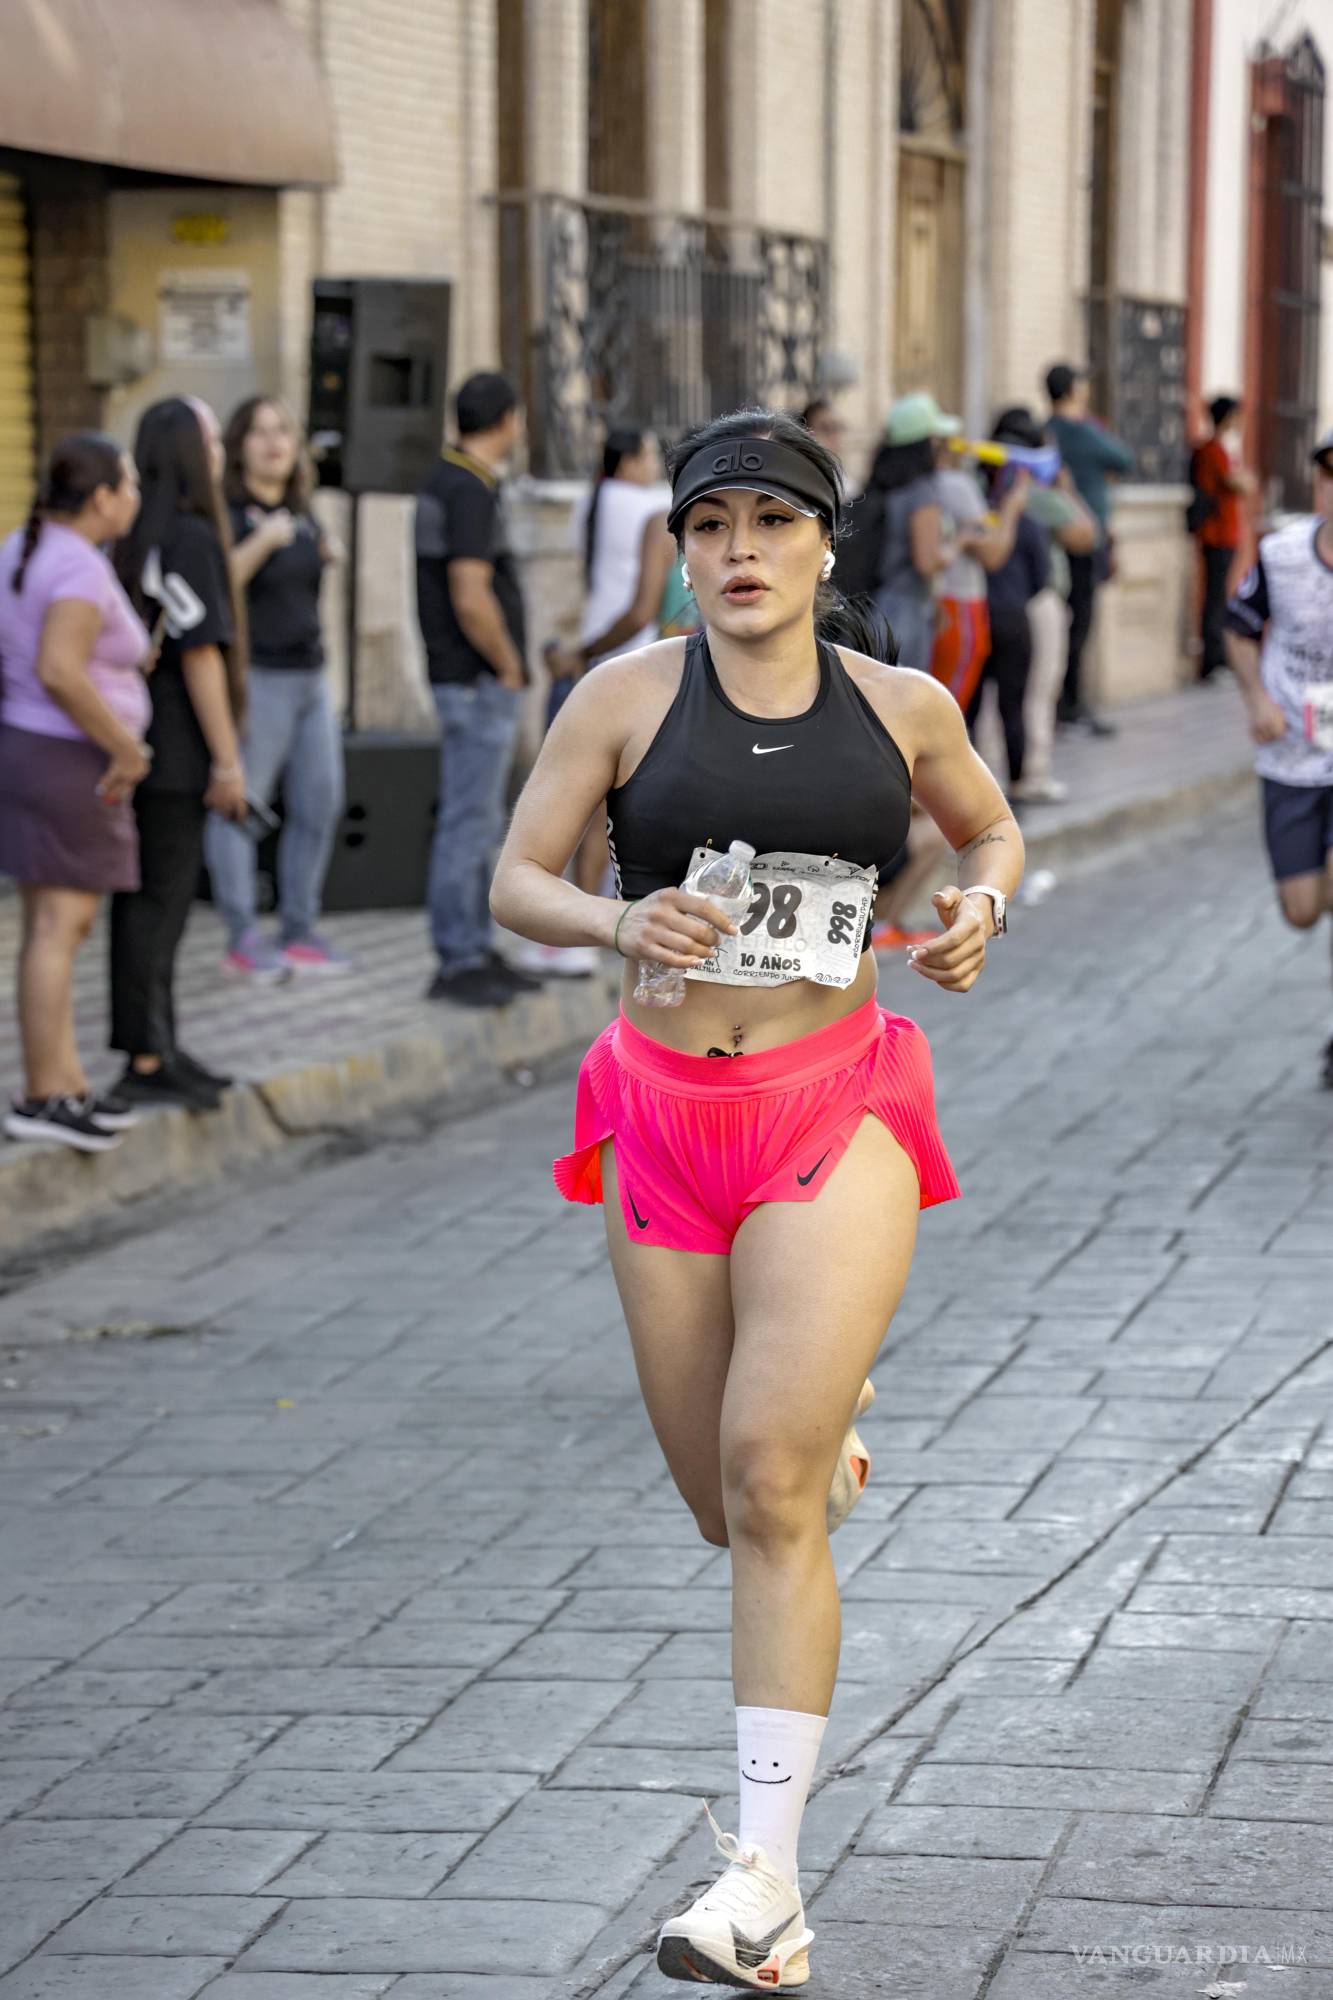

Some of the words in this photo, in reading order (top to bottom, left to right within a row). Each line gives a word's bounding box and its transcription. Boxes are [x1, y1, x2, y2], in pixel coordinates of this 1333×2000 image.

[740, 882, 802, 939] 98
[827, 900, 857, 945] 998
[733, 968, 780, 980] CORRIENDO
[740, 953, 756, 968] 10
[760, 953, 802, 972] AÑOS
